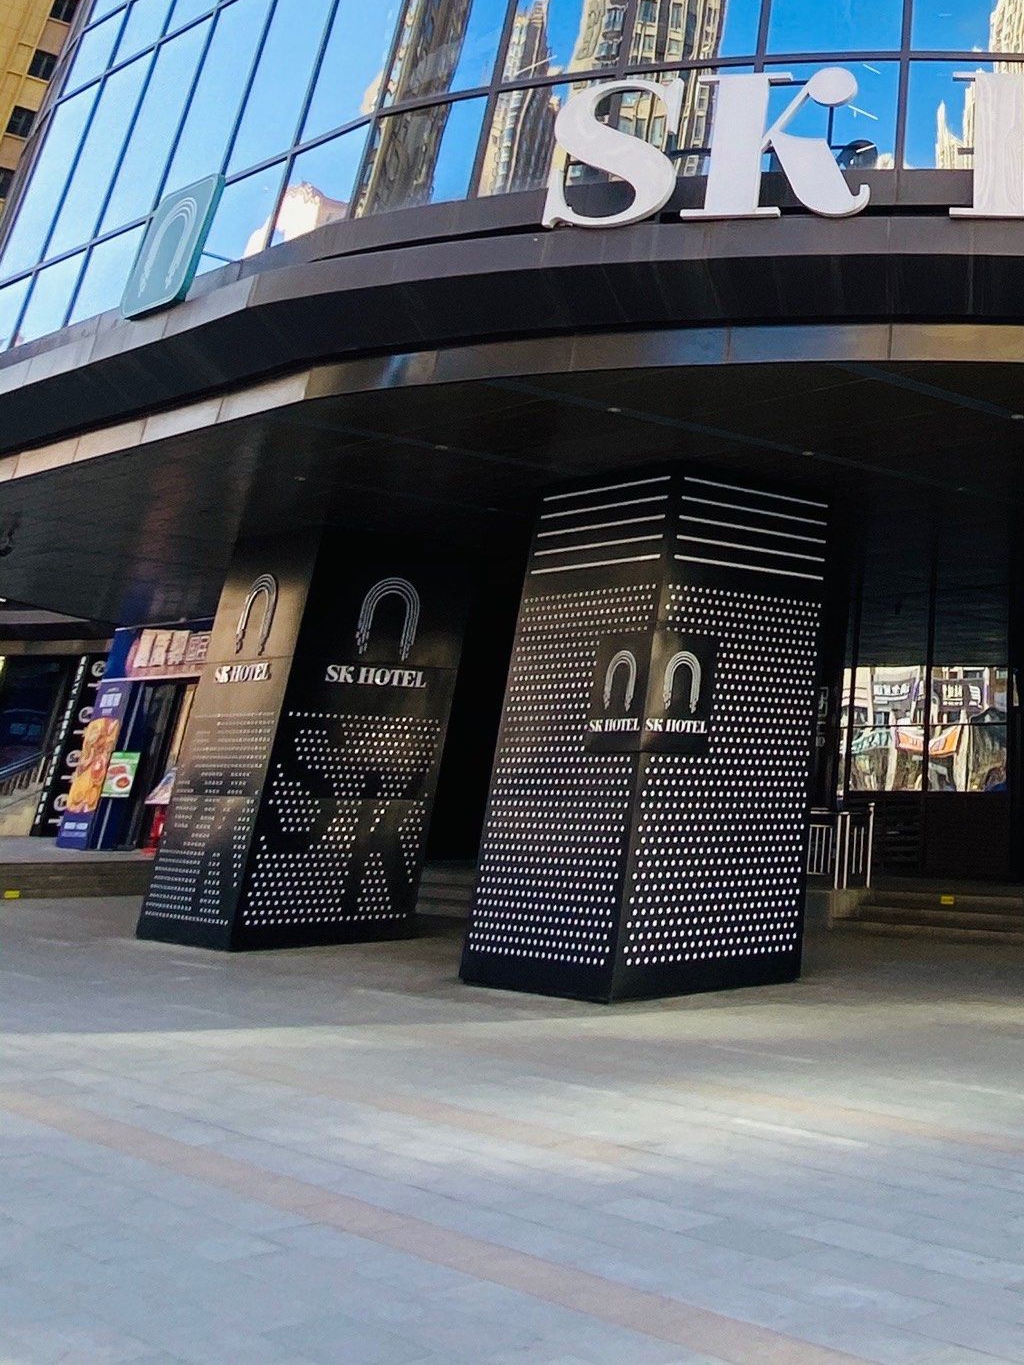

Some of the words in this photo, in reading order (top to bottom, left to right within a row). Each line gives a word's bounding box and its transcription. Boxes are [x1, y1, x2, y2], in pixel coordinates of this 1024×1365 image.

[541, 66, 871, 231] SK
[231, 662, 272, 682] HOTEL
[324, 664, 355, 683] SK
[357, 666, 427, 689] HOTEL
[588, 718, 604, 733] SK
[604, 717, 640, 733] HOTEL
[644, 718, 664, 733] SK
[665, 718, 708, 735] HOTEL
